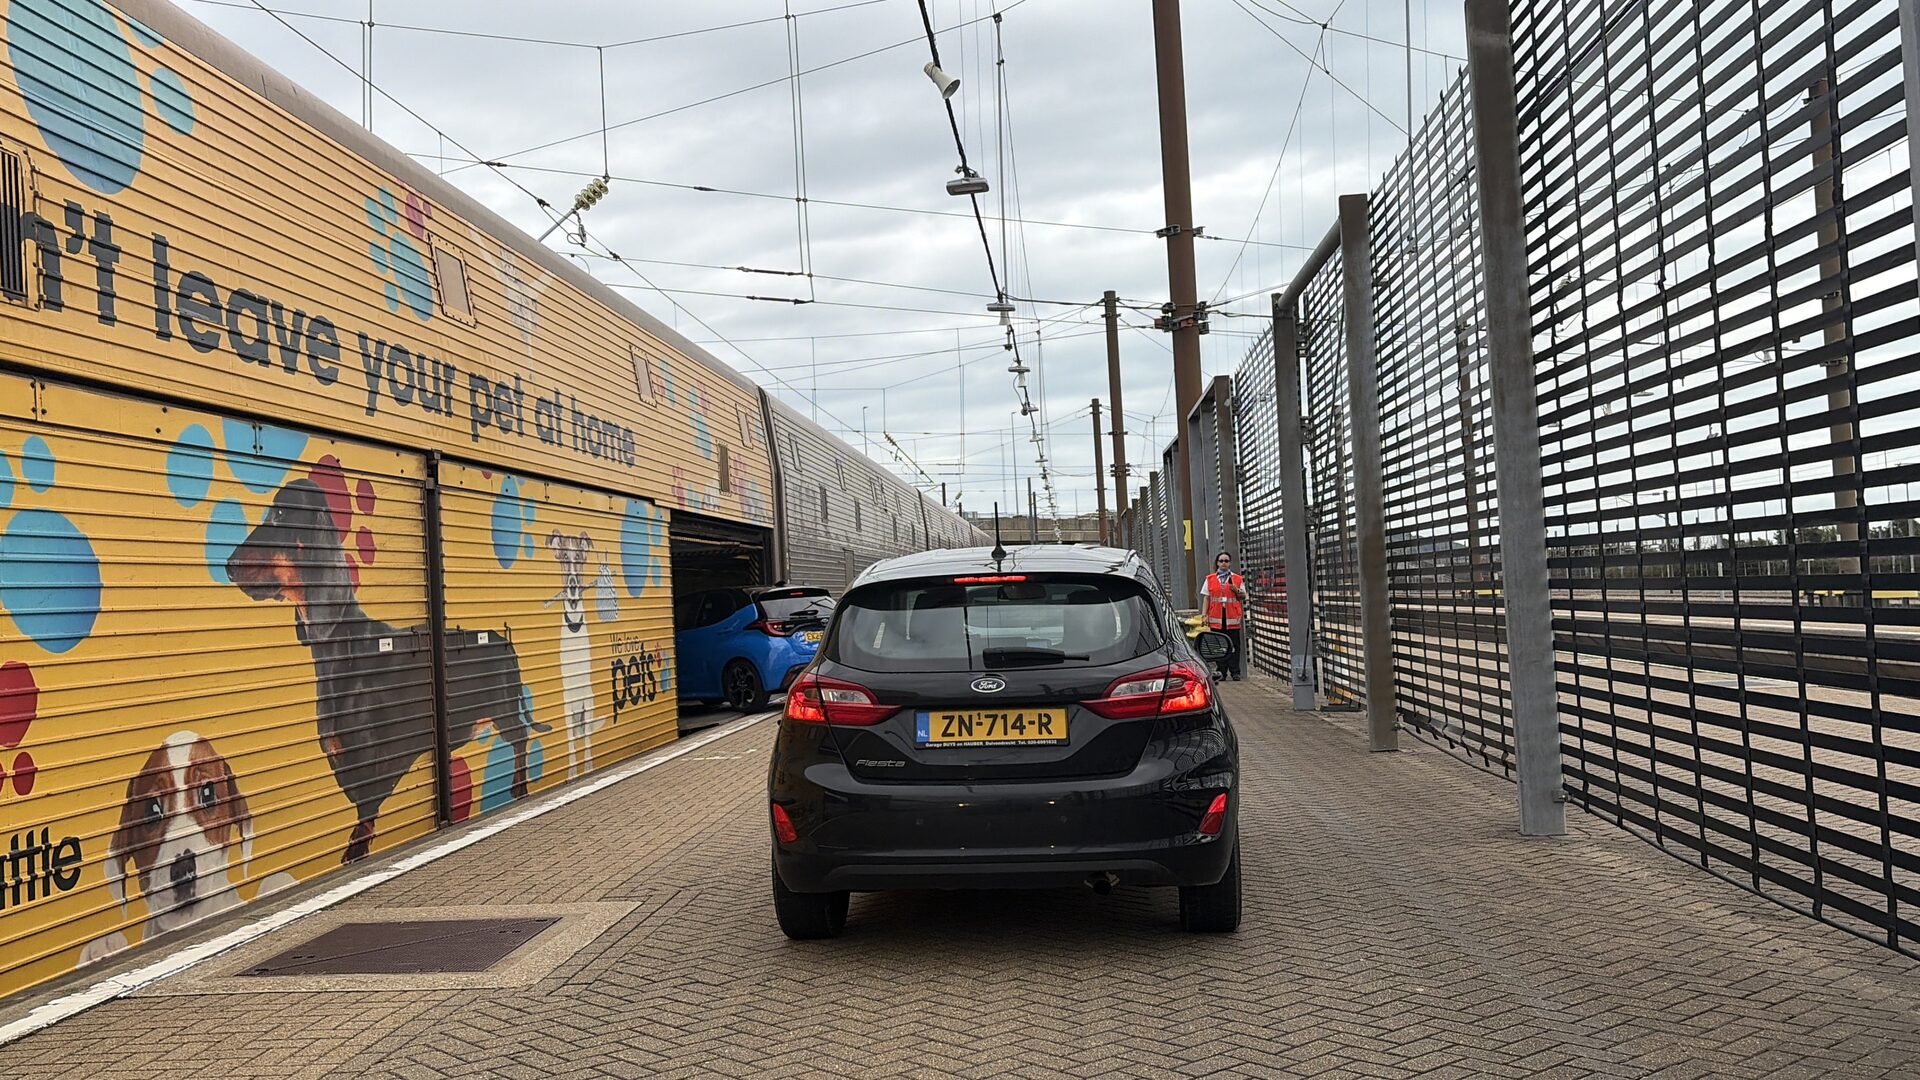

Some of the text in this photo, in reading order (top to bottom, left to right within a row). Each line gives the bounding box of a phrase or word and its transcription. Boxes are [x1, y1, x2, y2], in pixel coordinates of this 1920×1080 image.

[152, 232, 341, 385] leave
[357, 329, 455, 417] your
[469, 371, 525, 444] pet
[535, 389, 562, 446] at
[570, 395, 636, 468] home
[624, 632, 640, 653] love
[611, 642, 657, 724] pets
[941, 712, 1053, 737] ZN-714-R
[855, 759, 906, 767] Fiesta
